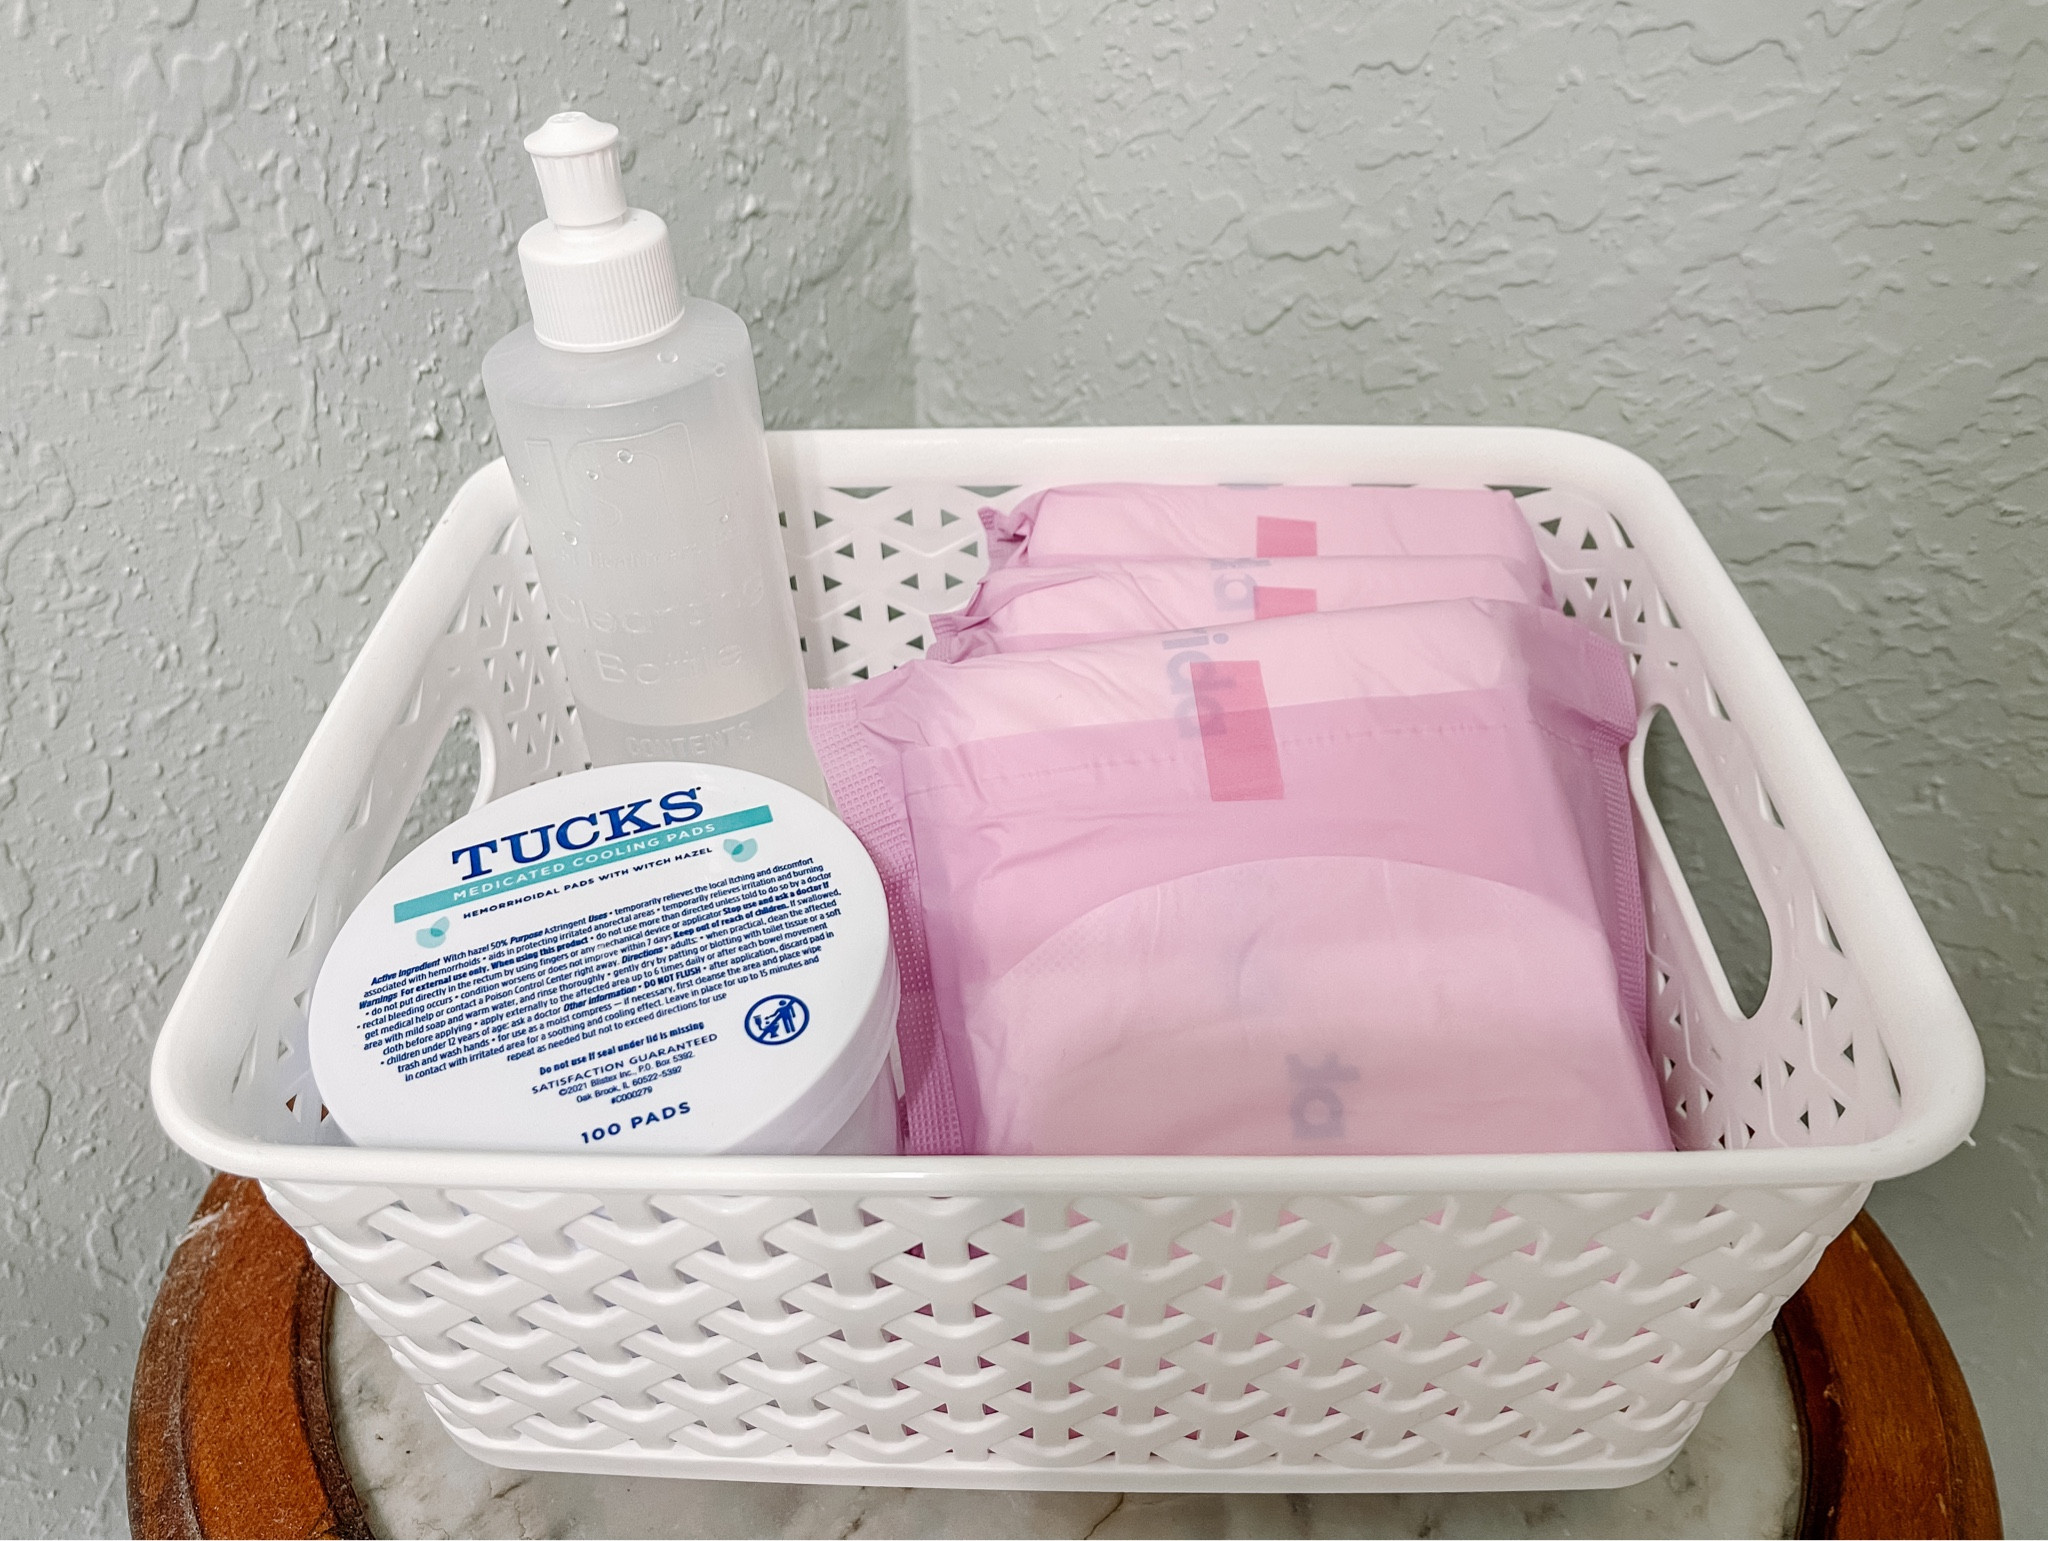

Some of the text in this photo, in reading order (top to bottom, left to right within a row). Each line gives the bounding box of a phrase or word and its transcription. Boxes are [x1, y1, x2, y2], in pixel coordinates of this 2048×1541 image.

[624, 719, 752, 757] CONTENTS
[451, 786, 703, 880] TUCKS
[453, 823, 714, 900] MEDICATED COOLING PADS
[370, 972, 396, 986] Active
[442, 951, 466, 963] Witch
[467, 943, 489, 956] hazel
[490, 938, 507, 950] 50%
[509, 929, 543, 944] Purpose
[544, 917, 586, 935] Astringent
[614, 897, 661, 915] temporarily
[662, 888, 693, 902] relieves
[708, 878, 727, 889] local
[772, 857, 813, 873] discomfort
[463, 847, 712, 918] HEMORRHOIDAL PADS WITH WITCH HAZEL
[358, 871, 831, 1009] Warnings external only. using product directed unless doctor
[362, 1014, 386, 1029] rectal
[387, 1004, 425, 1021] bleeding
[425, 995, 453, 1009] occurs
[460, 982, 499, 999] condition
[500, 971, 536, 987] worsens
[584, 949, 618, 964] improve
[619, 941, 646, 953] within
[720, 913, 744, 925] reach
[796, 888, 841, 905] swallowed,
[363, 864, 824, 998] associated with hemorrhoids protecting irritated anorectal areas temporarily relieves irritation burning
[380, 1016, 414, 1034] medical
[414, 1012, 434, 1023] help
[445, 998, 476, 1014] contact
[484, 989, 513, 1002] Poison
[514, 978, 544, 994] Control
[545, 971, 572, 985] Center
[573, 965, 594, 977] right
[621, 946, 663, 964] Directions
[729, 917, 766, 934] practical,
[767, 912, 788, 923] clean
[804, 898, 837, 913] affected
[414, 883, 821, 1002] directly rectum using fingers mechanical device applicator doctor
[490, 917, 808, 1011] water, rinse thoroughly gently patting blotting toilet tissue
[382, 921, 827, 1055] cloth before applying apply externally affected times daily after bowel movement
[386, 936, 808, 1065] children under 12 years doctor Other information DO NOT FLUSH after application, discard
[397, 950, 801, 1073] trash hands moist compress necessary, first cleanse place
[414, 960, 803, 1078] contact irritated soothing cooling Leave place 15 minutes
[506, 1000, 698, 1061] repeat needed exceed directions
[531, 1033, 717, 1094] SATISFACTION GUARANTEED
[539, 1066, 551, 1075] Do
[553, 1059, 568, 1071] not
[570, 1055, 586, 1066] use
[596, 1045, 615, 1058] seal
[617, 1038, 644, 1052] under
[645, 1032, 658, 1044] lid
[659, 1031, 667, 1040] is
[669, 1021, 704, 1037] missing
[654, 1058, 670, 1068] Box
[575, 1093, 592, 1103] Oak
[580, 1101, 690, 1144] 100 PADS
